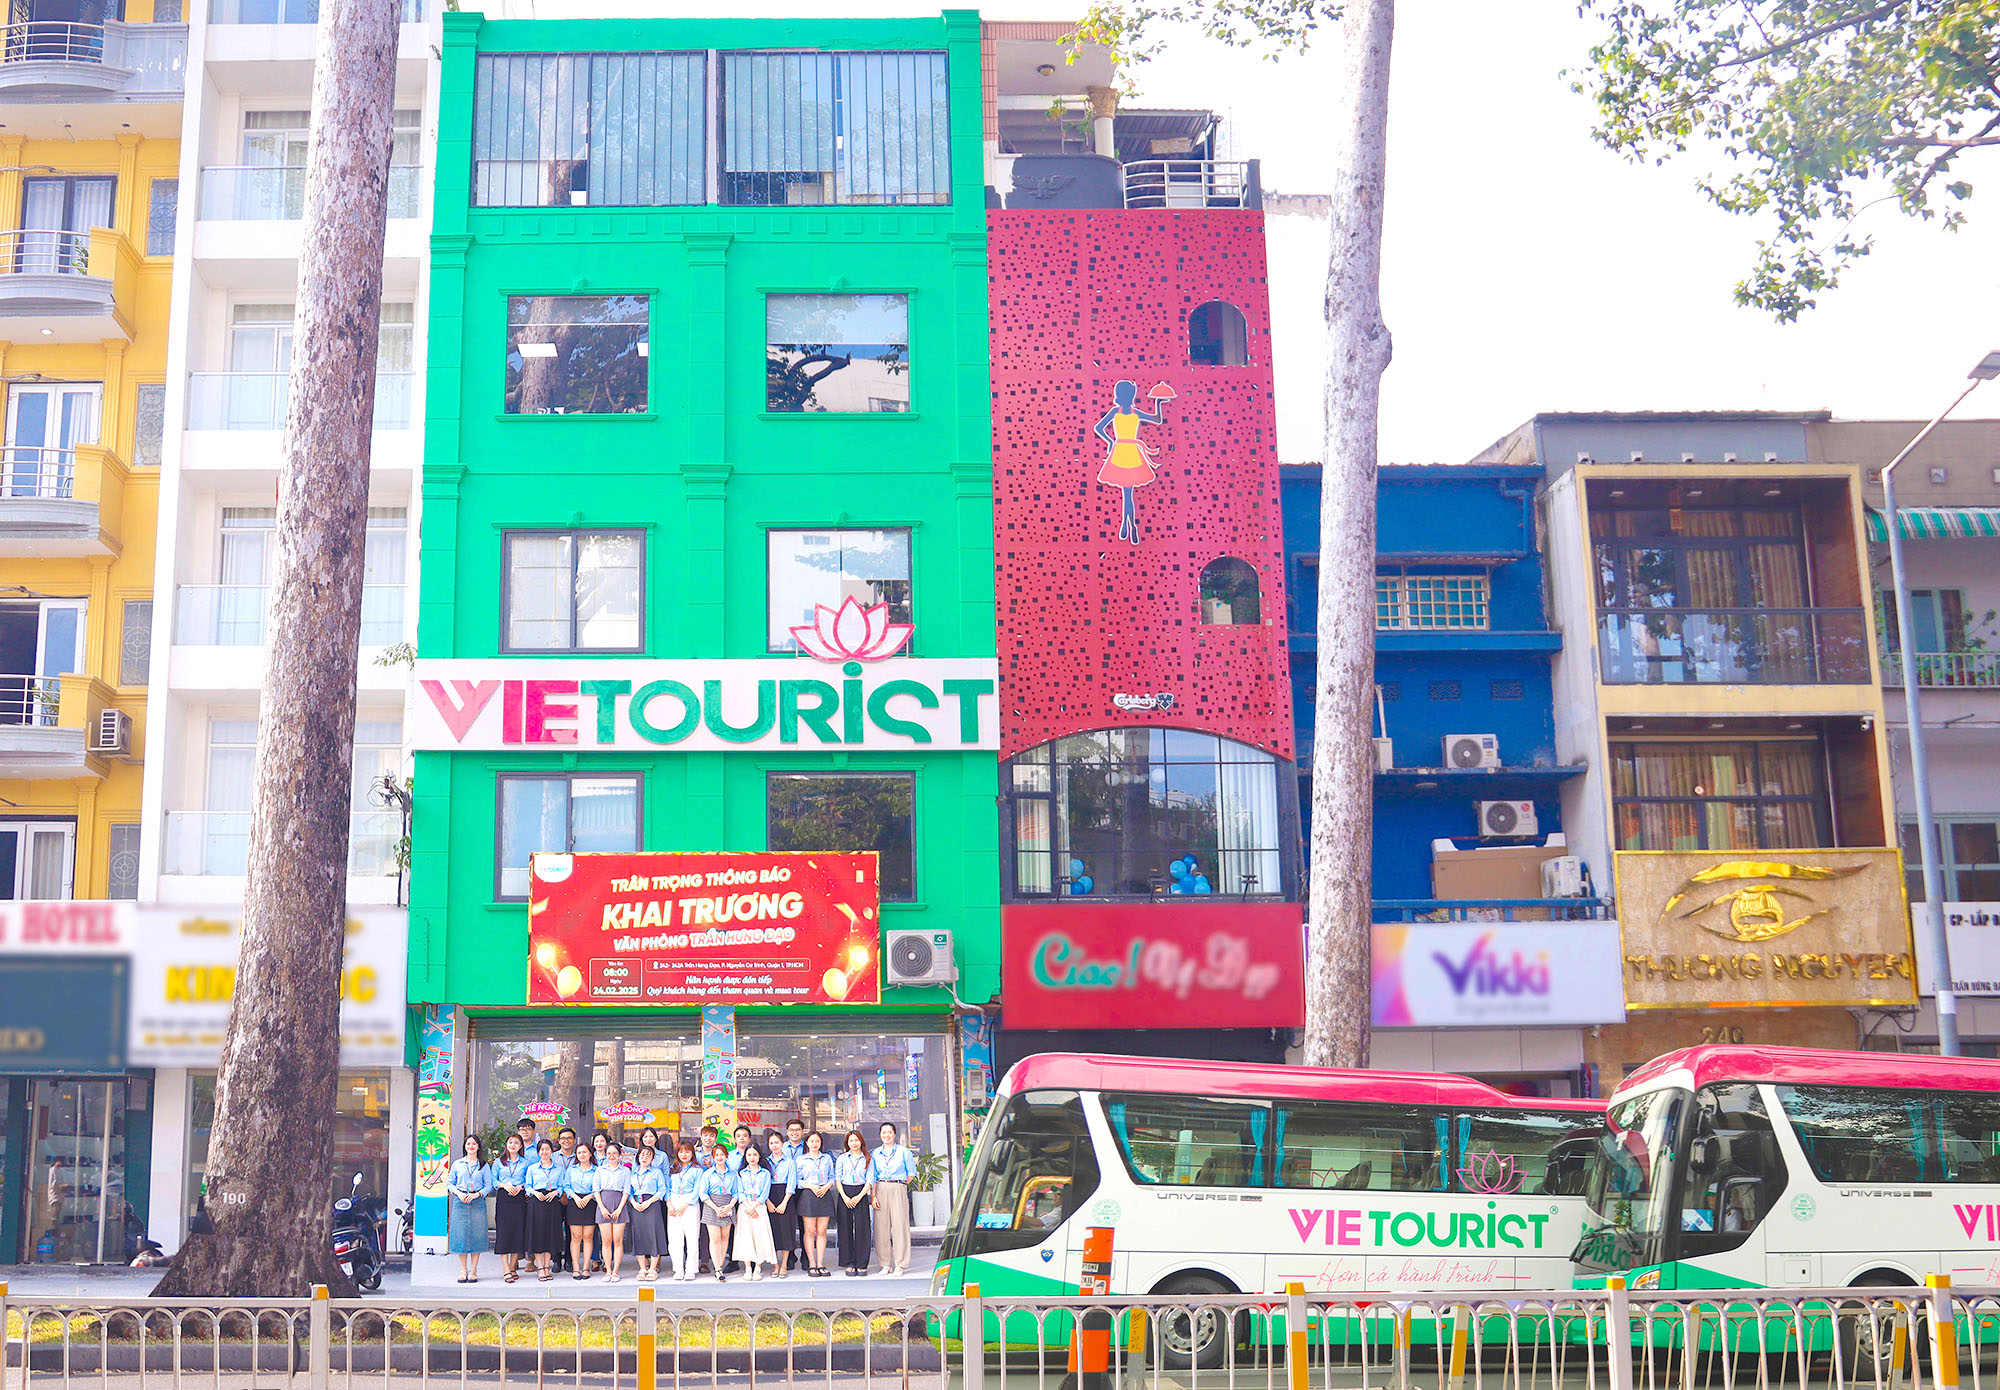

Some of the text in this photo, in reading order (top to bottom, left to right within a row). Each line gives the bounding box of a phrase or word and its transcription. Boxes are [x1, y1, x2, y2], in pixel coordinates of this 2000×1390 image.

[418, 661, 995, 745] VIETOURIST
[651, 873, 703, 892] TRỌNG
[705, 868, 757, 887] THÔNG
[759, 865, 791, 883] BÁO
[601, 891, 804, 931] KHAI TRƯƠNG
[613, 935, 640, 952] VĂN
[640, 932, 689, 951] PHÒNG
[764, 927, 795, 945] ĐẠO
[1433, 930, 1550, 996] Vikki
[603, 968, 629, 977] 08:00
[703, 976, 722, 985] hạnh
[723, 976, 741, 985] được
[742, 975, 757, 984] đón
[758, 974, 773, 985] tiếp
[592, 986, 639, 995] 24.02.2025
[646, 986, 662, 996] Quý
[663, 986, 685, 994] khách
[687, 986, 706, 996] hàng
[707, 985, 721, 994] đến
[722, 986, 742, 994] tham
[743, 987, 763, 996] quan
[764, 986, 774, 994] và
[793, 986, 810, 994] tour
[222, 1192, 246, 1204] 190
[1157, 1193, 1238, 1201] UNIVERSE
[1396, 1258, 1442, 1283] hành
[1446, 1258, 1496, 1284] trình
